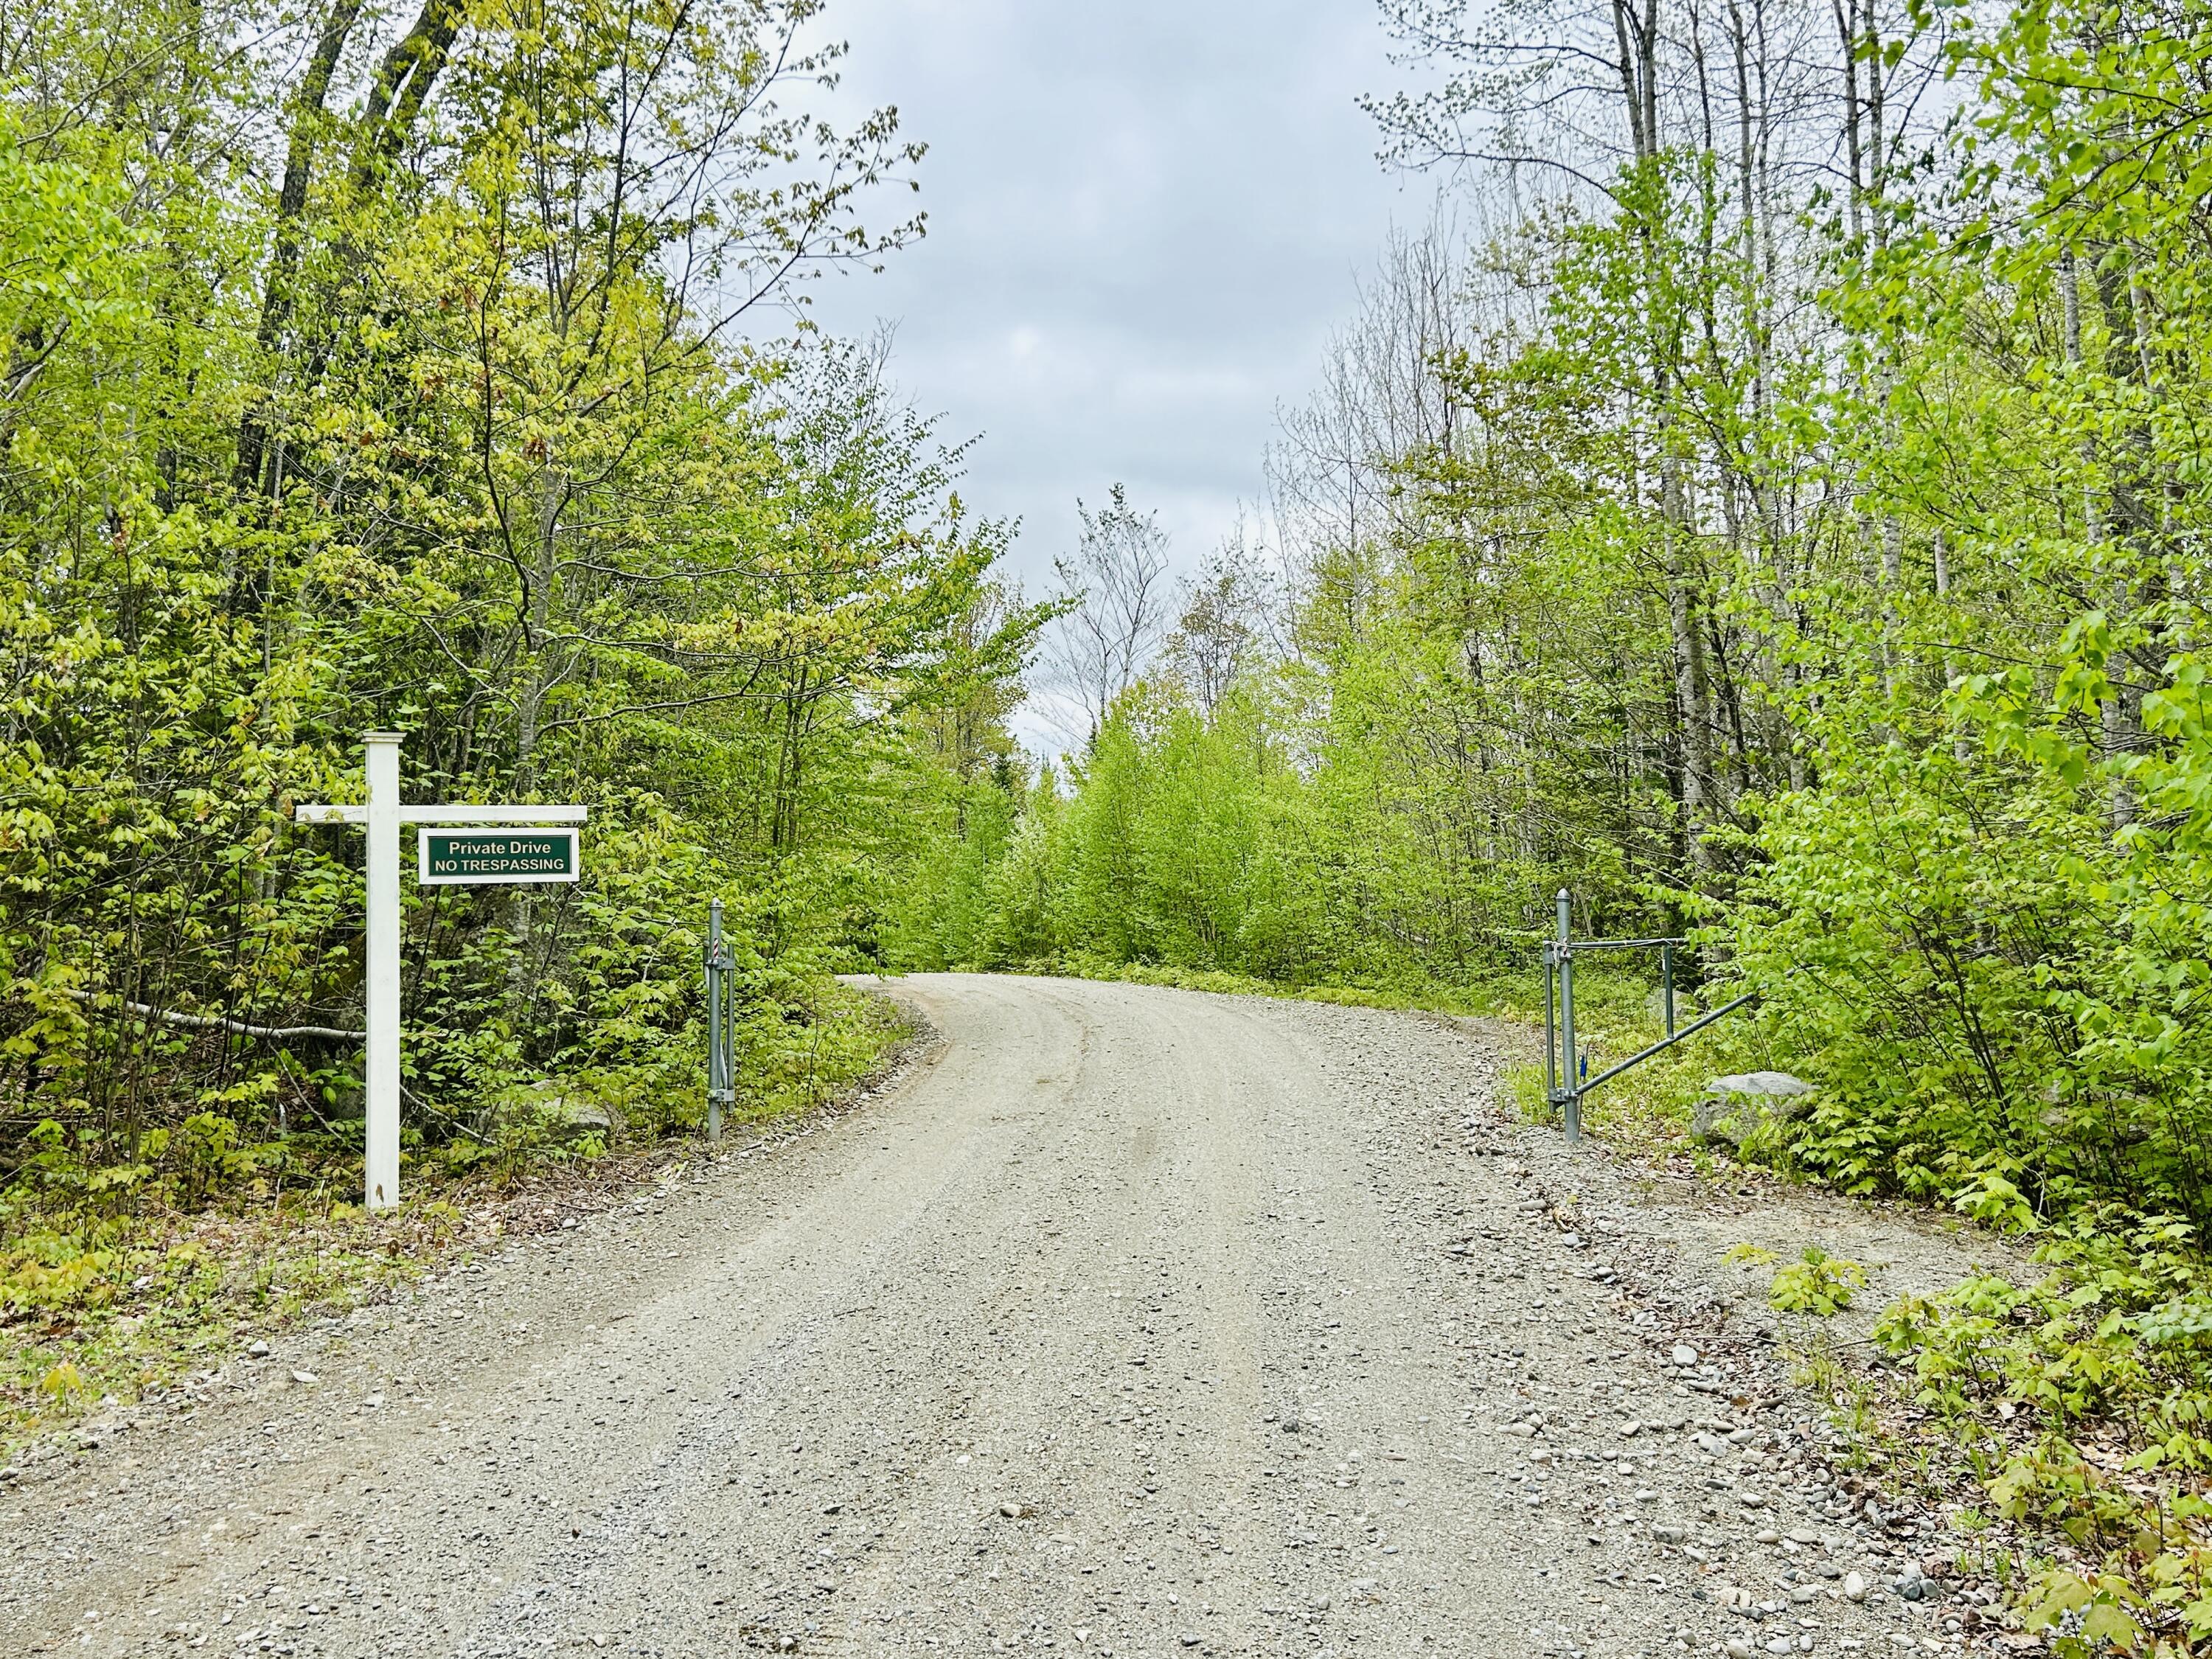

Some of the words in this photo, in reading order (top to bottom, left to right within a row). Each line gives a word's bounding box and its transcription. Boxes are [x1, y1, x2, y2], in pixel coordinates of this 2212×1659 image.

[449, 841, 505, 855] Private
[510, 841, 551, 854] Drive
[435, 860, 457, 872] NO
[461, 858, 564, 871] TRESPASSING
